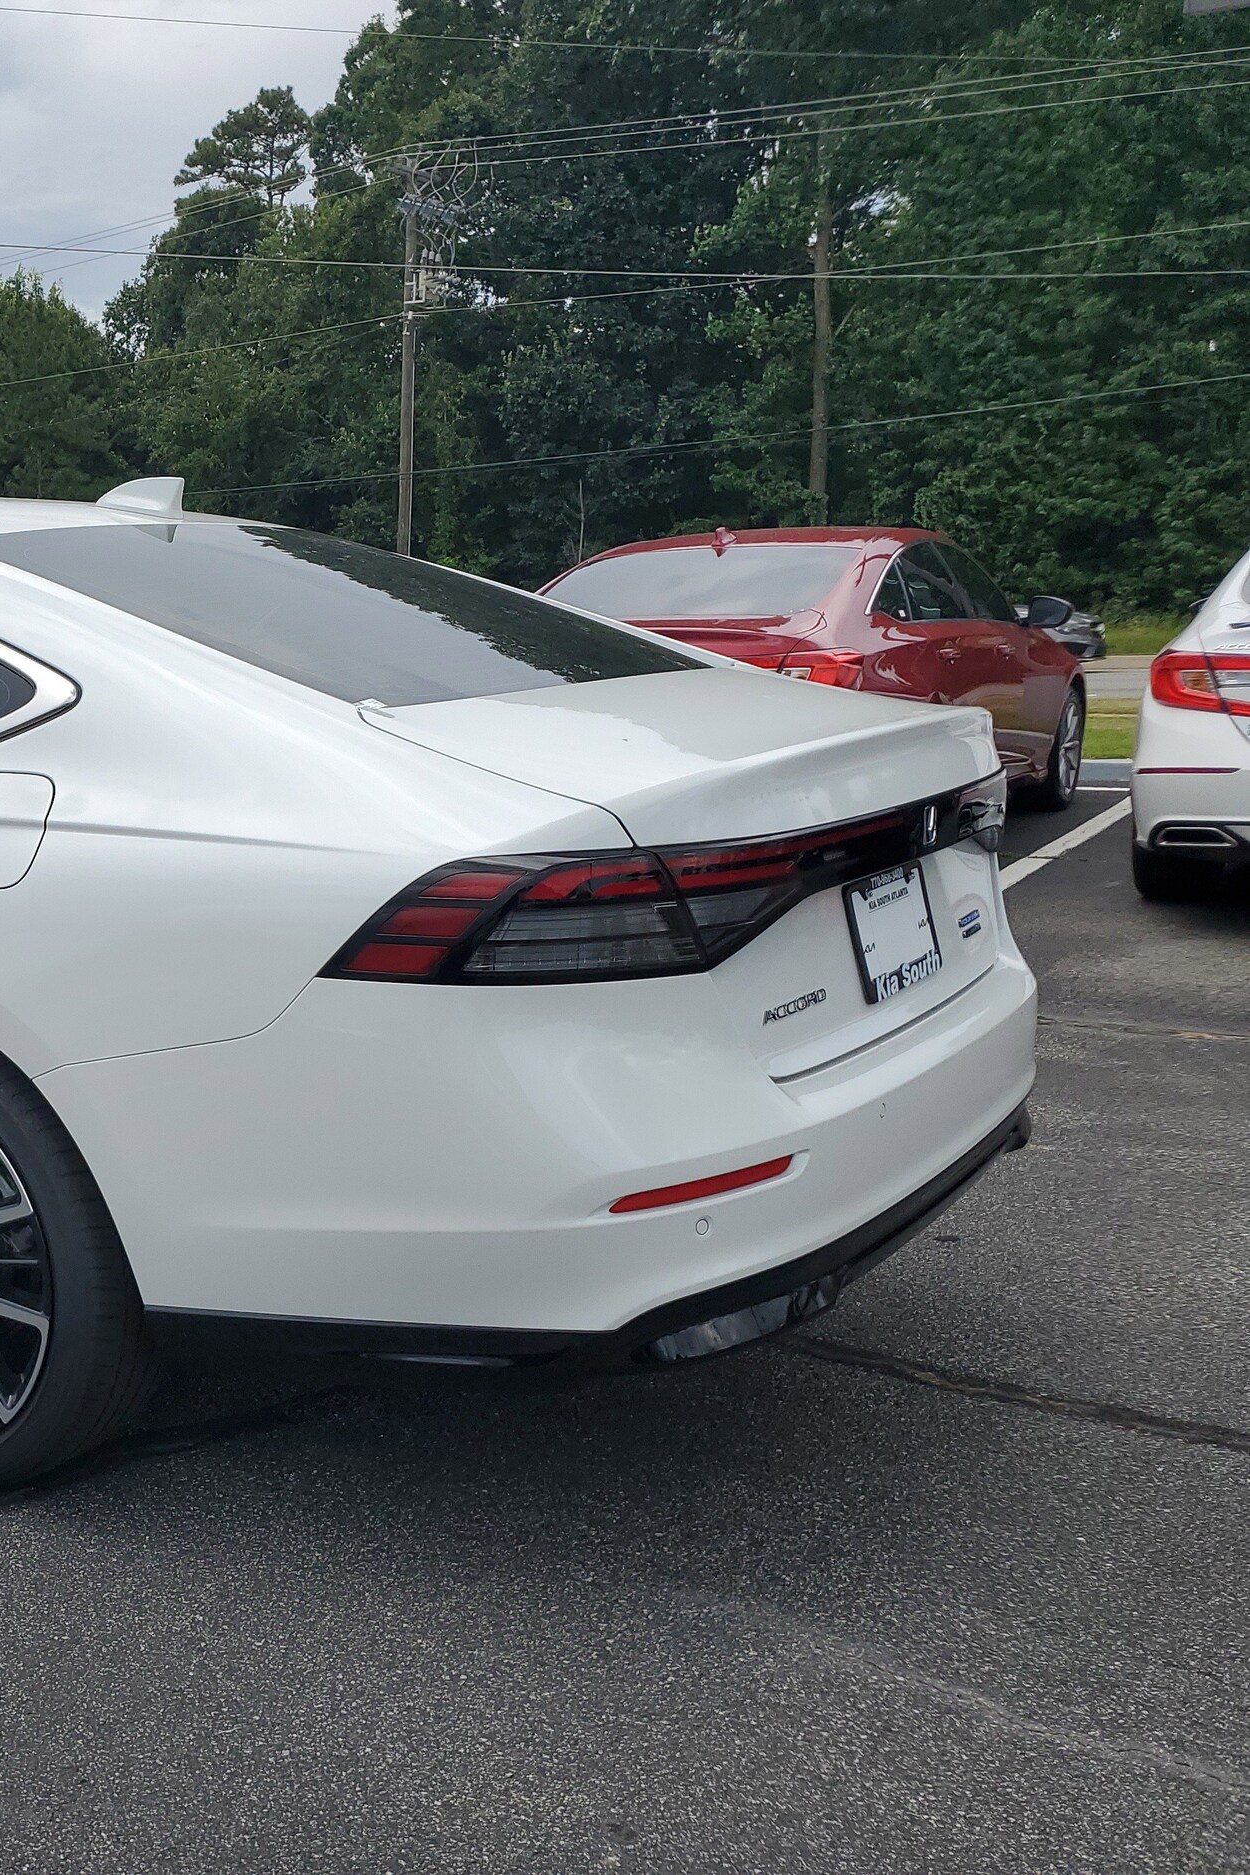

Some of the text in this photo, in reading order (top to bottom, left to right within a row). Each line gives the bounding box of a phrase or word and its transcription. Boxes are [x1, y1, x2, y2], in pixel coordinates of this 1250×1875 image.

[876, 949, 940, 1002] Kia South
[762, 988, 827, 1026] ACCORD
